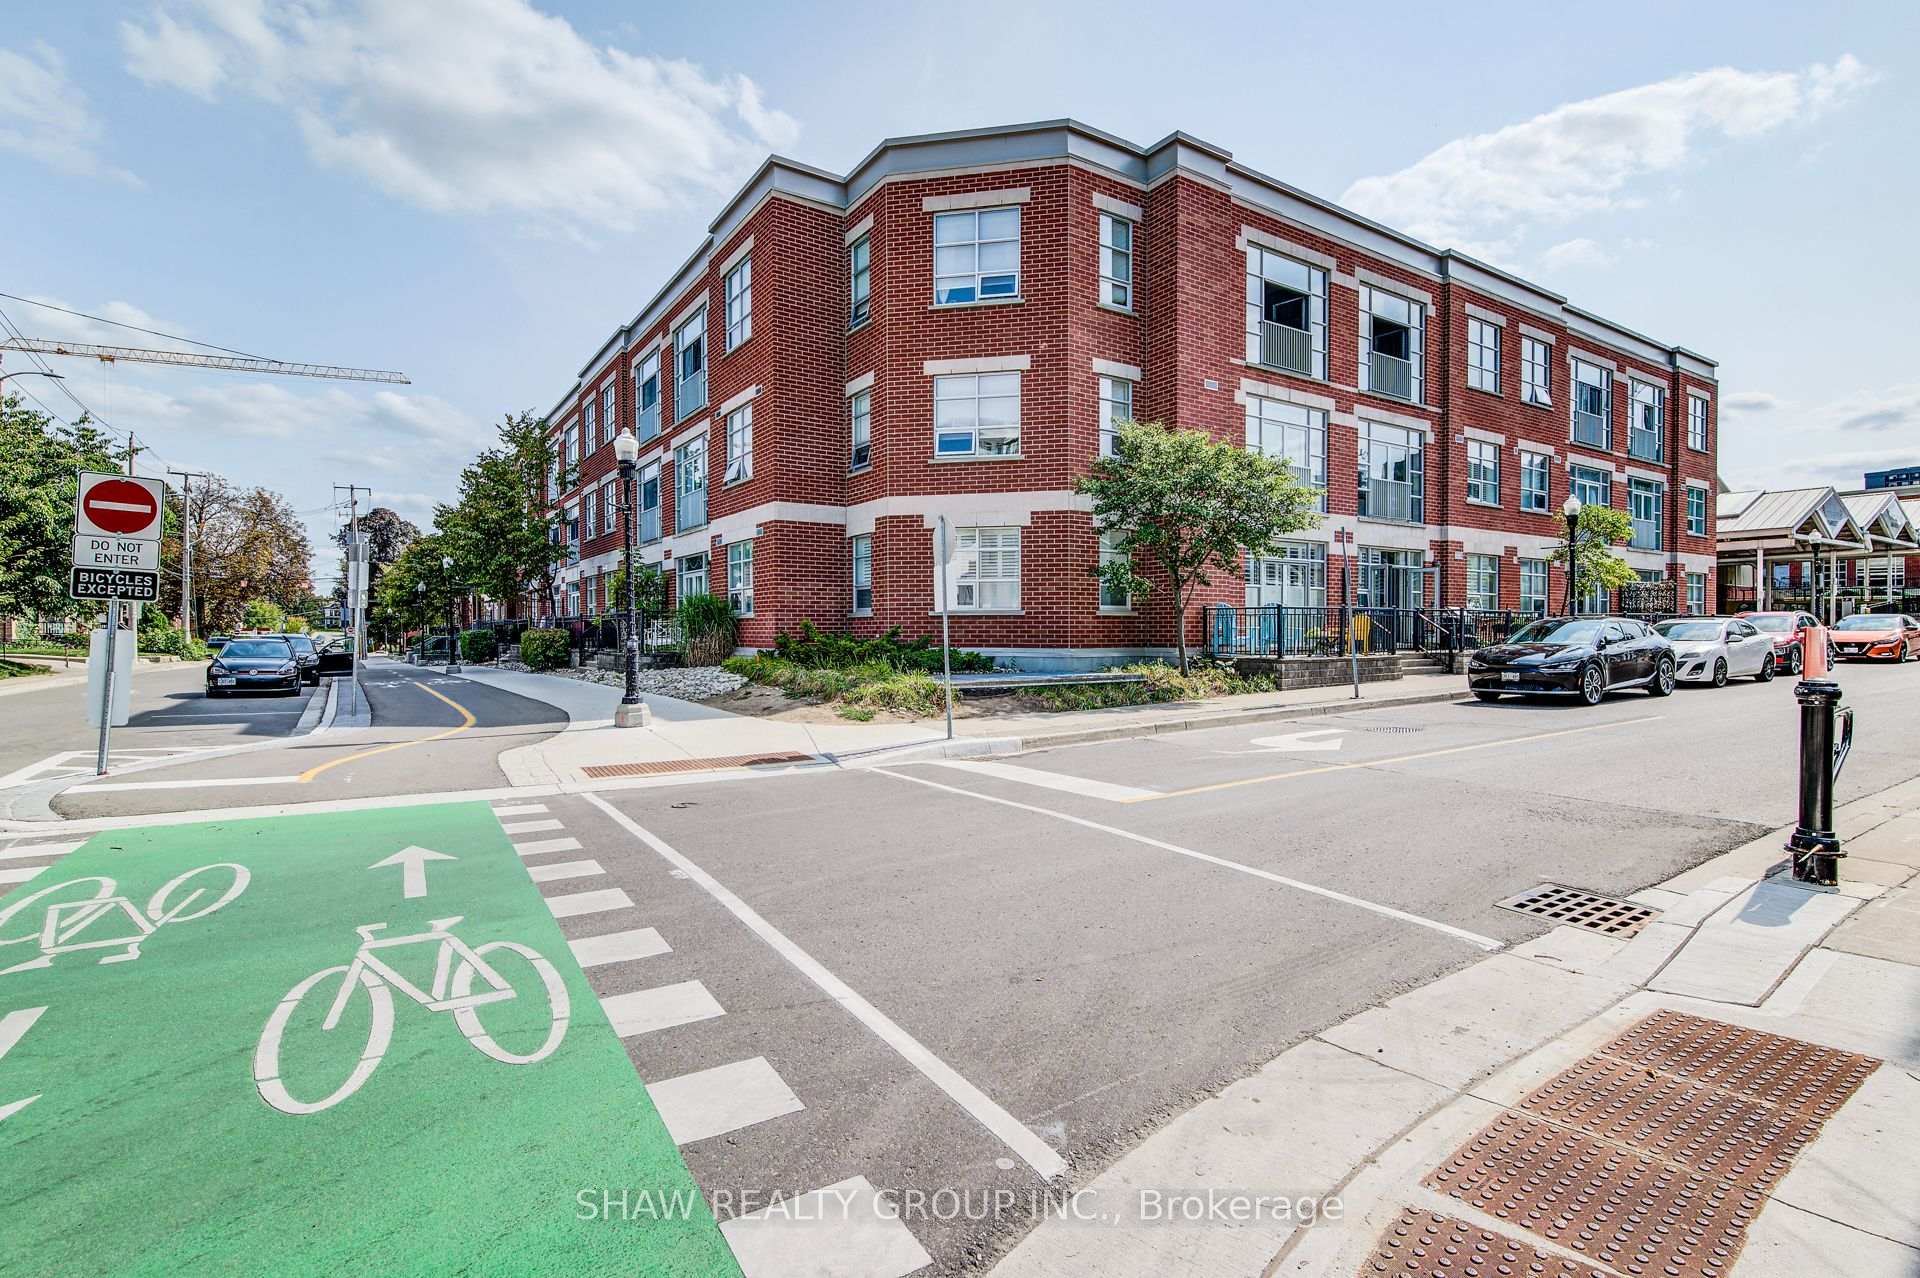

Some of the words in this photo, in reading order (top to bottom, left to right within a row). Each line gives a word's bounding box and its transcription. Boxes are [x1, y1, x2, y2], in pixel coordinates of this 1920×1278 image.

[91, 540, 110, 551] DO
[117, 542, 143, 553] NOT
[94, 553, 139, 565] ENTER
[79, 572, 153, 586] BICYCLES
[77, 583, 153, 597] EXCEPTED
